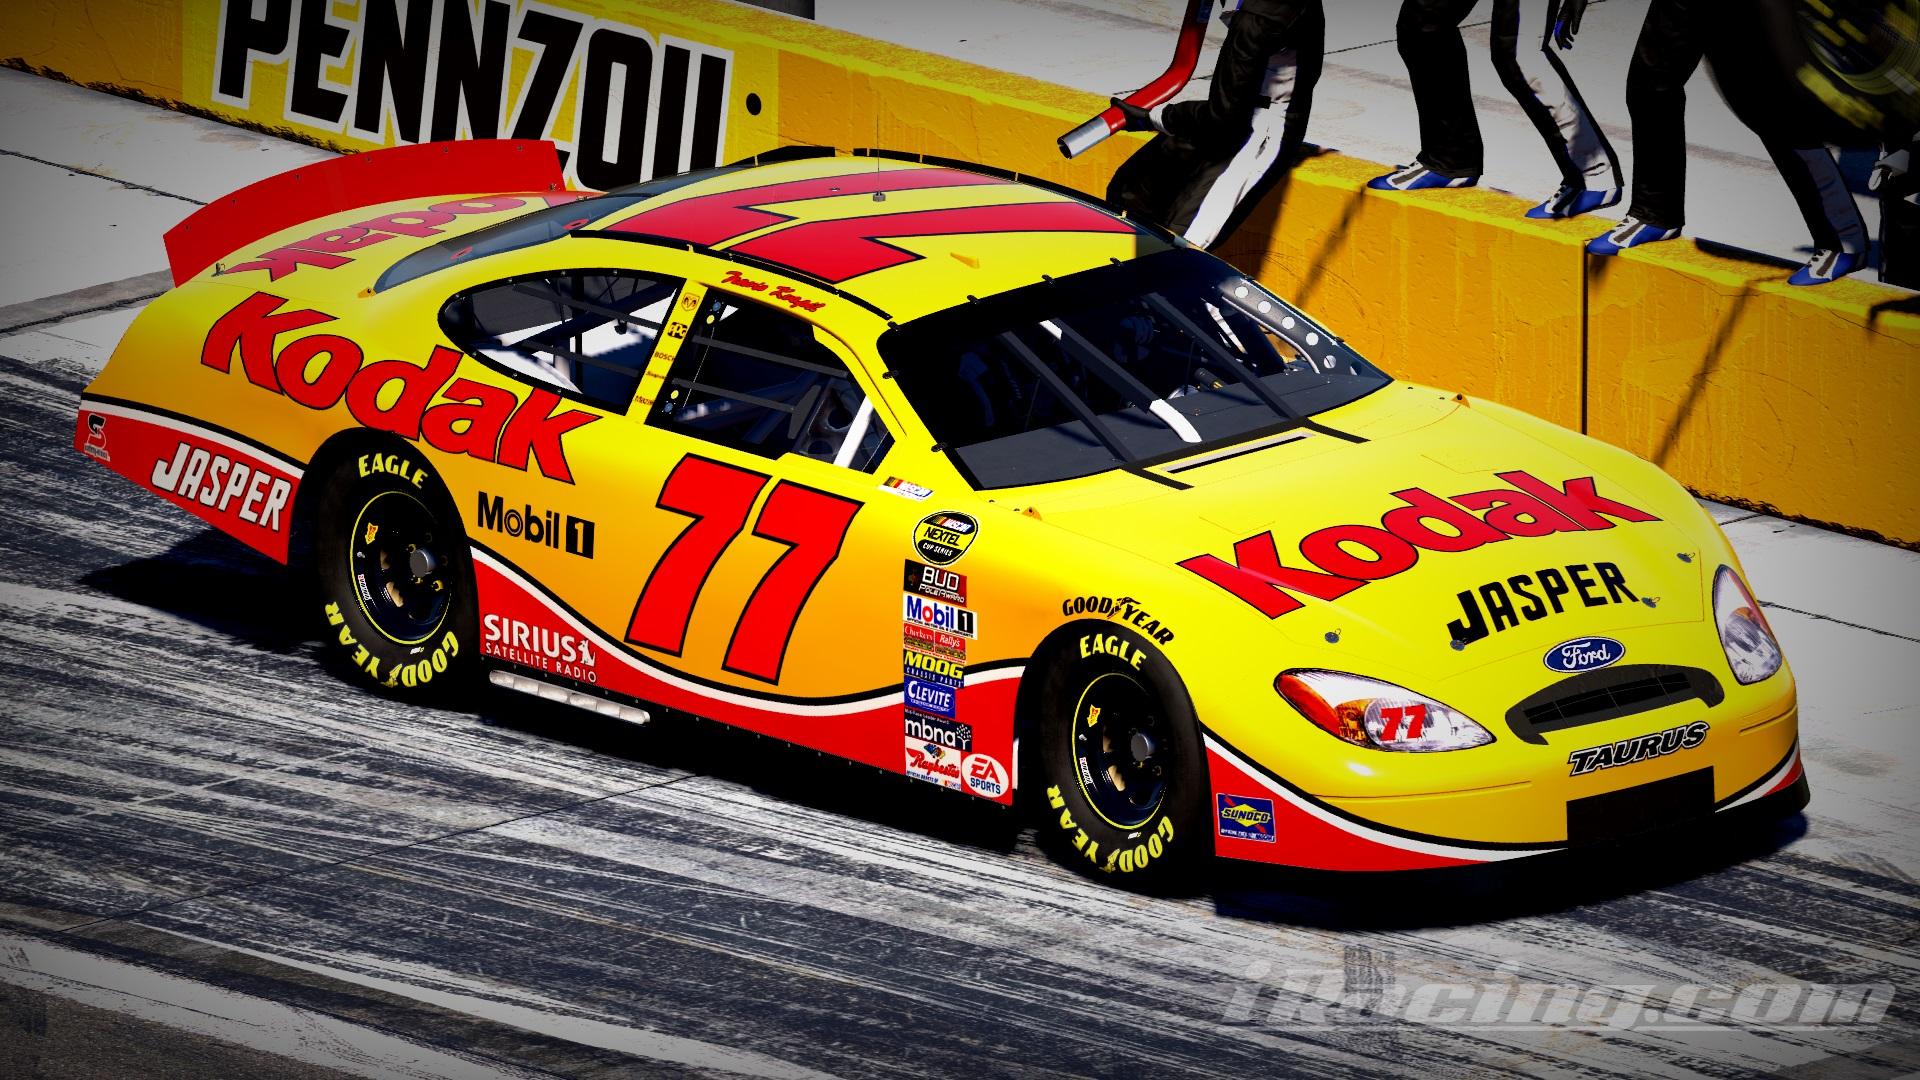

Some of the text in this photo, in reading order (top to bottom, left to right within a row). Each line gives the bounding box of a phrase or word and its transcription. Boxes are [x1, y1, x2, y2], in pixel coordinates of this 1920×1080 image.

[200, 290, 603, 485] Kodak
[151, 441, 293, 533] JASPER
[358, 452, 428, 489] EAGLE
[477, 491, 560, 550] Mobil
[924, 526, 960, 546] NEXTEL
[922, 542, 954, 557] CUP SERIES
[1175, 470, 1663, 620] Kodak
[624, 452, 866, 686] 77
[922, 566, 960, 591] BUD
[907, 595, 955, 629] Mobil
[1447, 561, 1640, 646] JASPER
[483, 613, 577, 663] SIRIUS
[940, 634, 961, 648] Rally's
[1080, 633, 1147, 671] EAGLE
[1562, 641, 1611, 669] Ford
[485, 641, 598, 684] SATELLITE RADIO
[904, 651, 963, 680] MOOG
[907, 680, 952, 708] CLEVITE
[904, 718, 956, 747] mbna
[1381, 703, 1426, 742] 77
[1568, 720, 1711, 777] TAURUS
[970, 757, 1000, 784] EA
[970, 777, 1001, 795] SPORTS
[1223, 808, 1269, 822] SUNOCO
